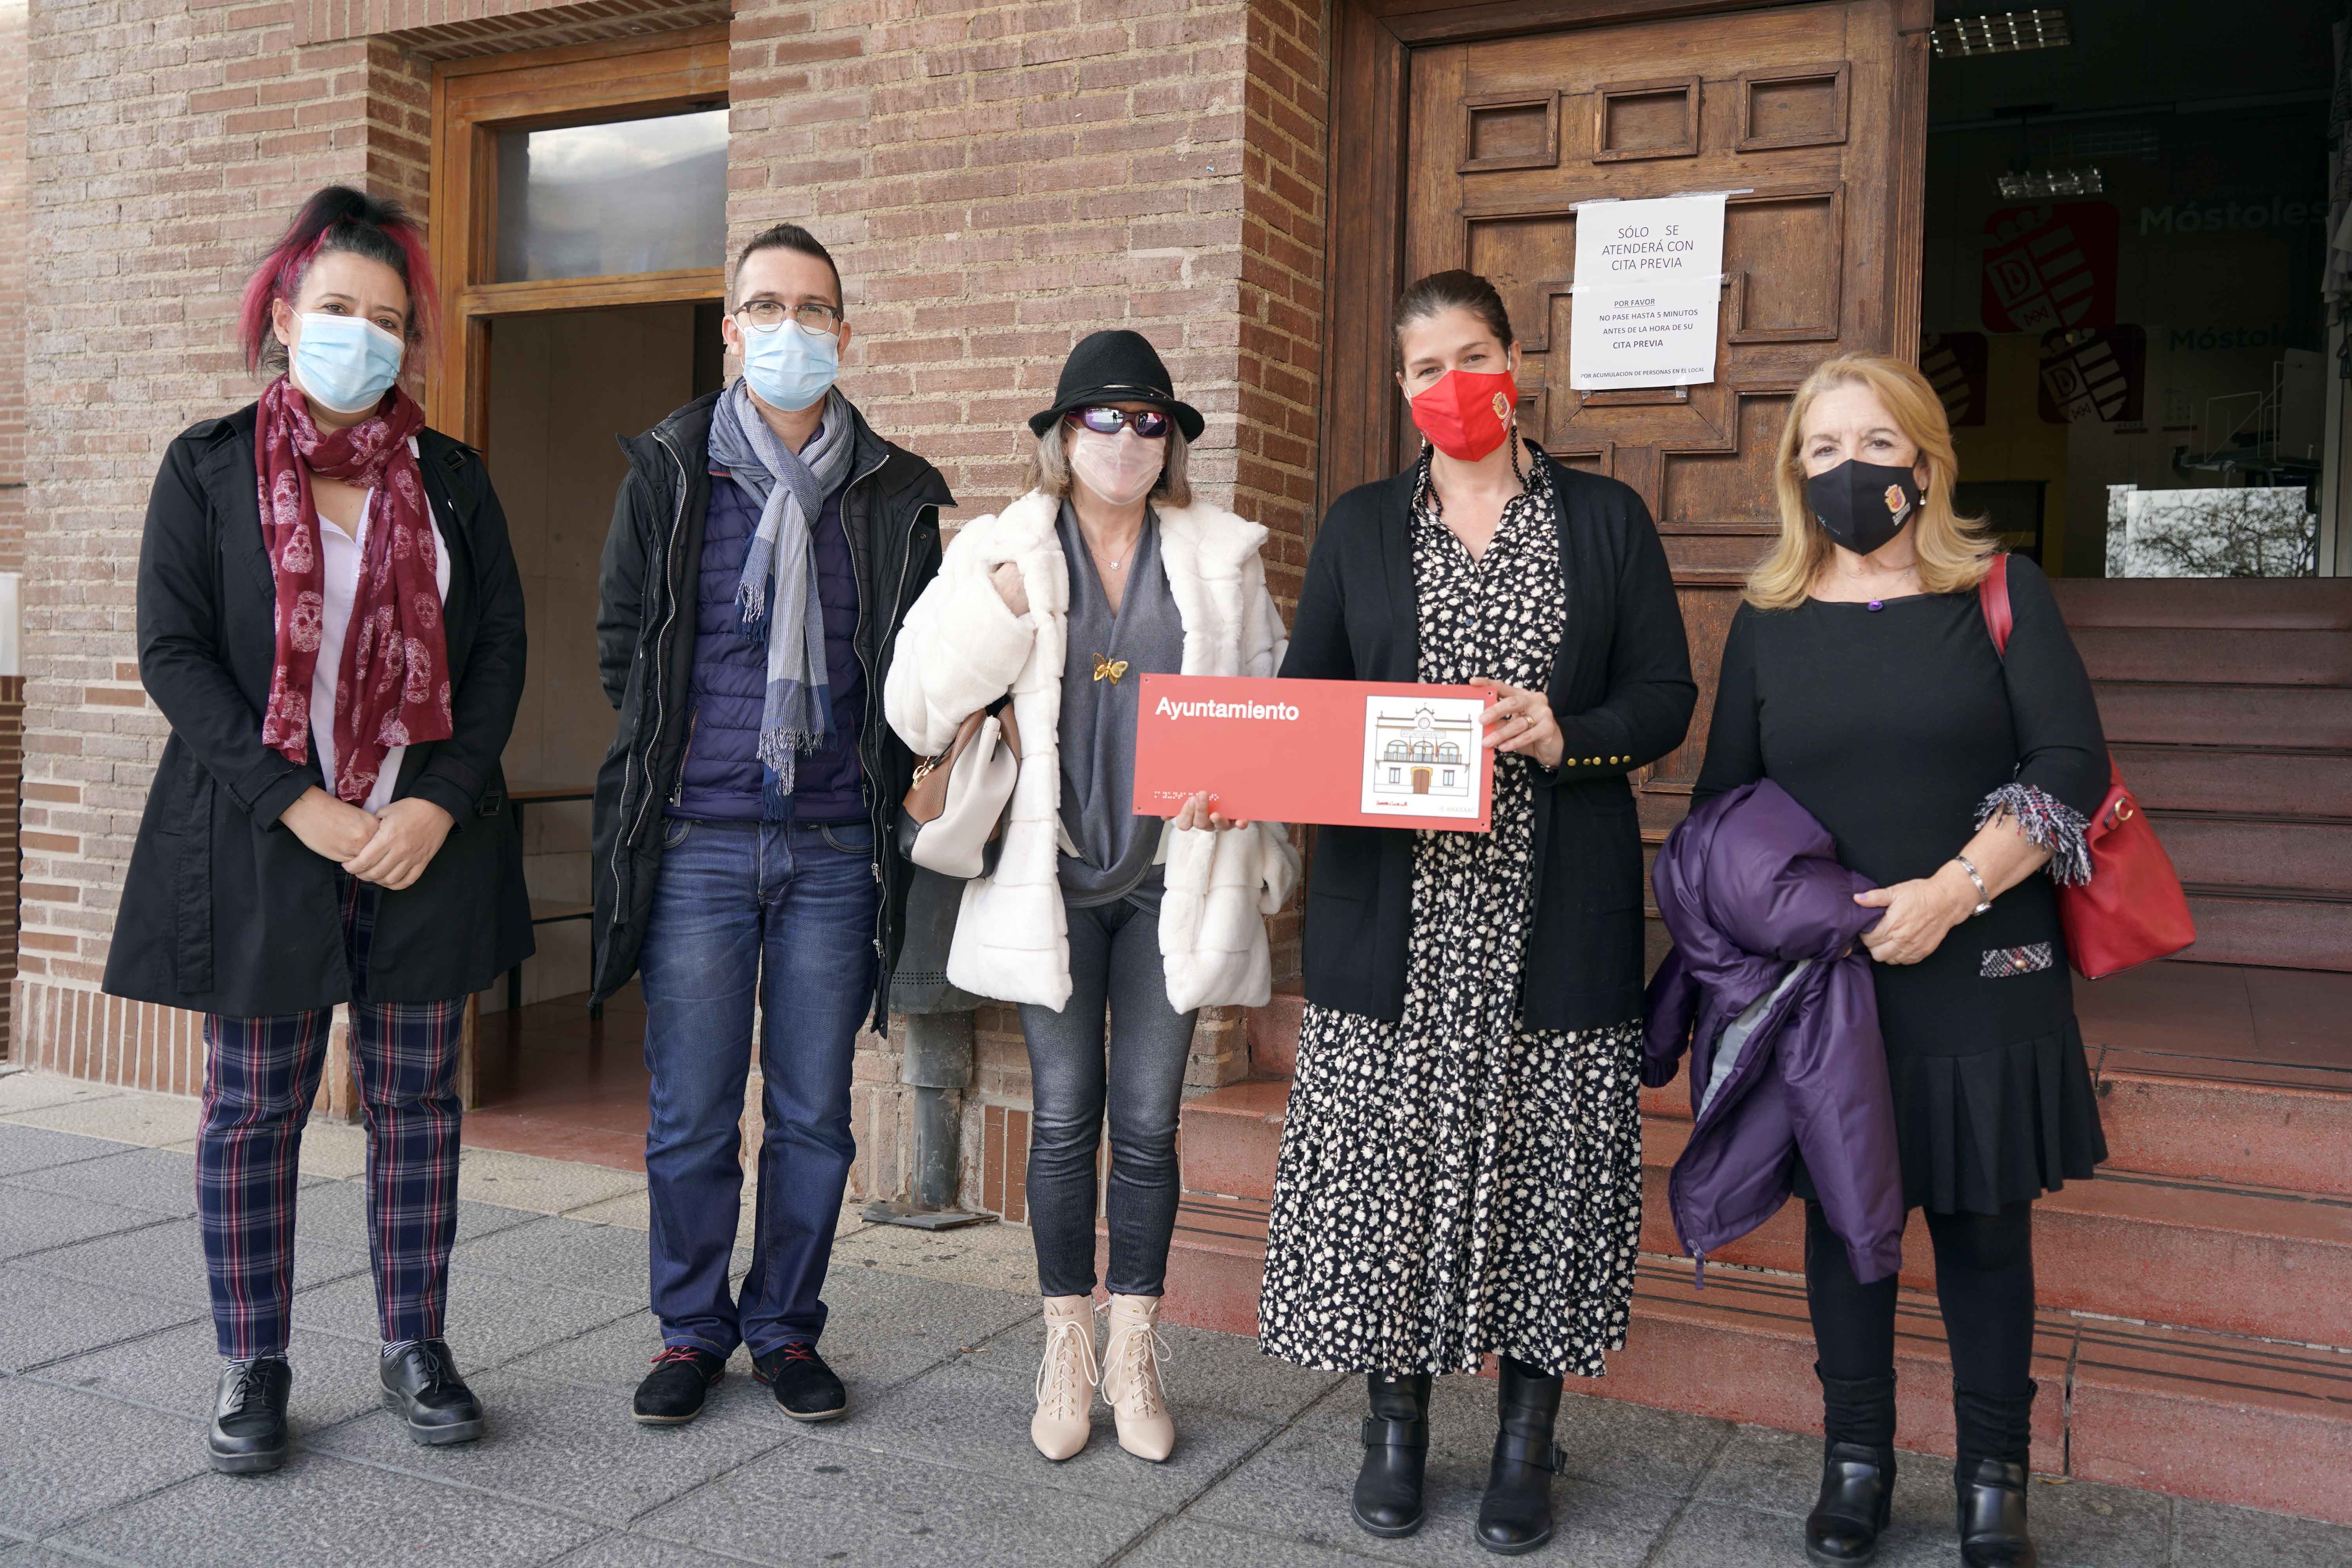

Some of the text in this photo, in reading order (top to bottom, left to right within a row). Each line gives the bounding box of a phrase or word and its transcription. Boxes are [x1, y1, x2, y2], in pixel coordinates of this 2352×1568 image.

[2139, 195, 2328, 236] Móstoles
[1618, 225, 1679, 239] SÓLO SE
[1602, 240, 1693, 255] ATENDERÁ CON
[1612, 257, 1682, 270] CITA PREVIA
[1631, 298, 1655, 307] FAVOR
[1663, 309, 1698, 317] MINUTOS
[1633, 339, 1663, 348] PREVIA
[1155, 697, 1299, 720] Ayuntamiento
